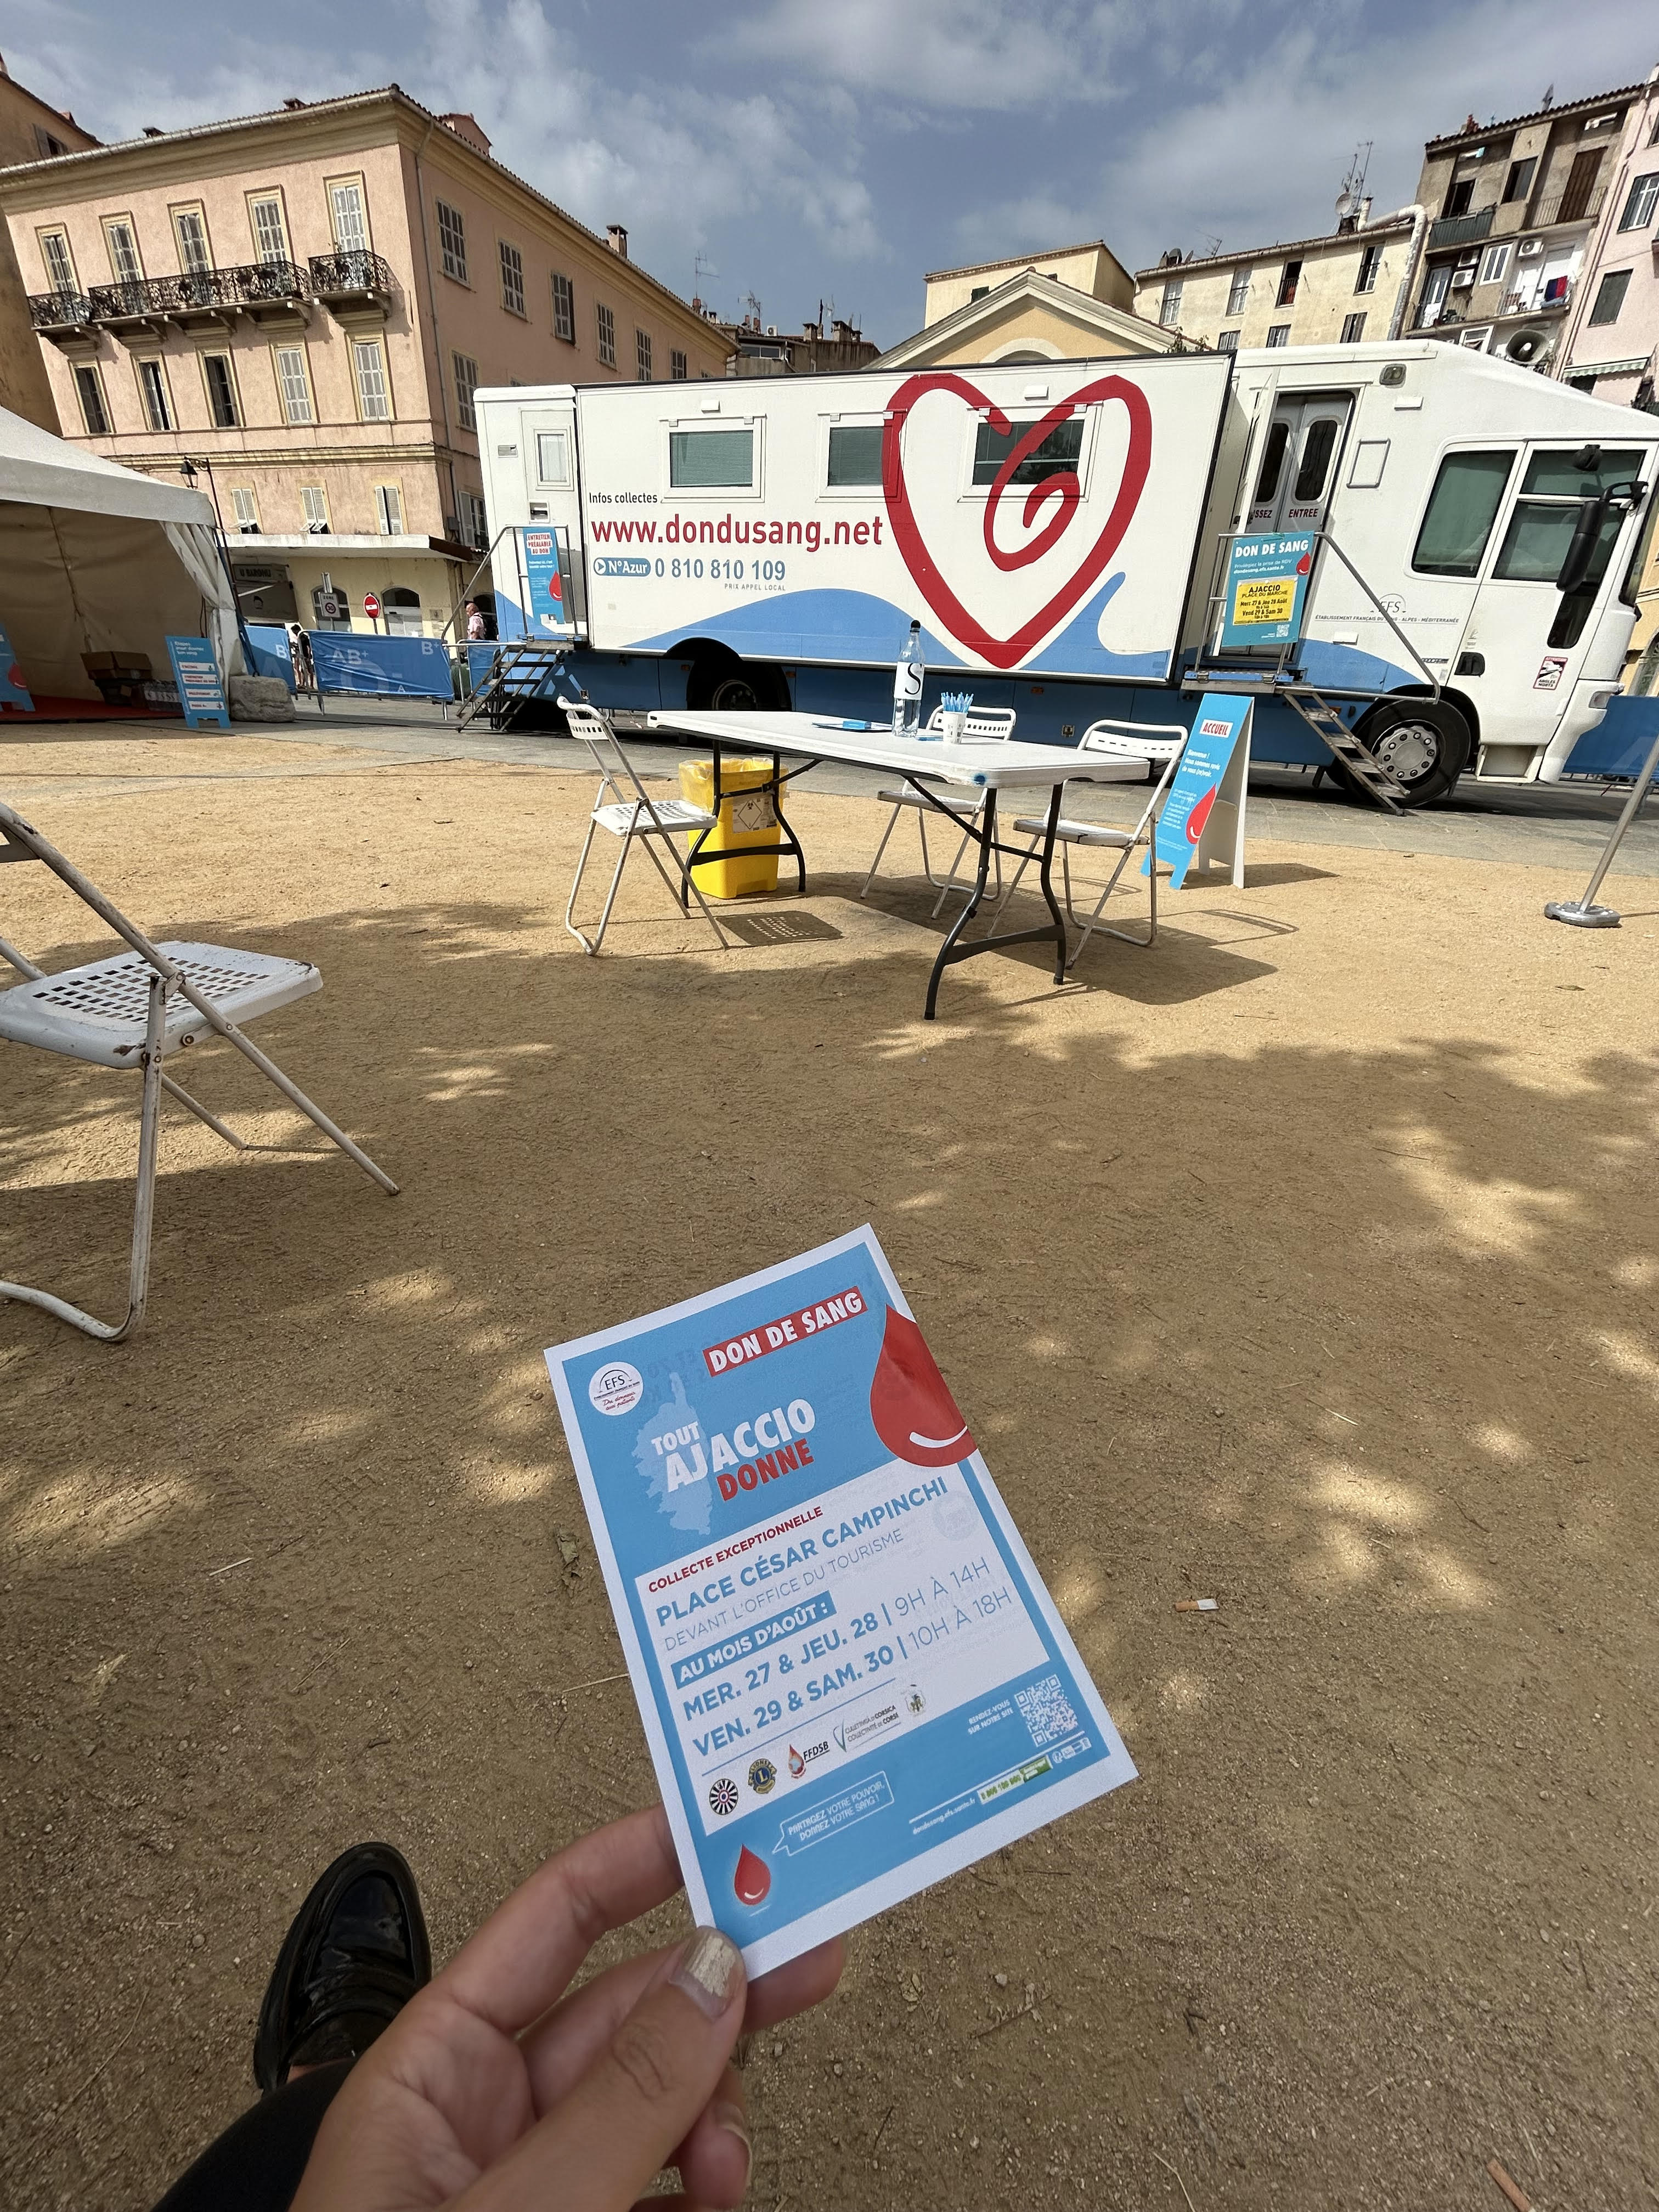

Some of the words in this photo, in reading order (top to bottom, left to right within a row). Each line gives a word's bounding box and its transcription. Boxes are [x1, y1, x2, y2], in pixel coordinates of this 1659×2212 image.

[589, 493, 612, 503] Infos
[615, 493, 658, 503] collectes
[1288, 509, 1318, 517] ENTREE
[591, 514, 883, 552] www.dondusang.net
[1235, 545, 1259, 557] DON
[1262, 543, 1276, 555] DE
[1278, 540, 1308, 554] SANG
[655, 558, 664, 577] 0
[672, 558, 703, 578] 810
[710, 559, 743, 579] 810
[752, 560, 786, 580] 109
[1249, 585, 1280, 593] AJACCIO
[1203, 723, 1229, 735] ACCUEIL
[709, 1333, 762, 1372] DON
[765, 1319, 798, 1348] DE
[802, 1293, 862, 1333] SANG
[605, 1375, 625, 1390] EFS
[651, 1421, 700, 1455] TOUT
[666, 1399, 815, 1492] AJACCIO
[716, 1438, 814, 1501] DONNE
[648, 1556, 714, 1593] COLLECTE
[716, 1506, 823, 1562] EXCEPTIONNELLE
[656, 1576, 736, 1627] PLACE
[741, 1539, 819, 1586] CÉSAR
[822, 1476, 948, 1548] CAMPINCHI
[664, 1611, 728, 1651] DEVANT
[732, 1578, 800, 1619] L'OFFICE
[803, 1566, 825, 1585] DU
[828, 1528, 904, 1572] TOURISME
[680, 1658, 704, 1682] AU
[707, 1636, 752, 1667] MOIS
[754, 1604, 816, 1645] D'AOÛT
[683, 1682, 742, 1721] MER.
[746, 1662, 770, 1691] 27
[779, 1654, 794, 1674] &
[801, 1629, 847, 1664] JEU.
[850, 1612, 878, 1639] 28
[895, 1589, 926, 1616] 9H
[930, 1577, 948, 1600] À
[950, 1557, 990, 1588] 14H
[693, 1718, 751, 1756] VEN.
[754, 1700, 782, 1729] 29
[788, 1691, 803, 1711] &
[806, 1663, 862, 1701] SAM.
[864, 1646, 893, 1672] 30
[909, 1617, 949, 1650] 10H
[953, 1605, 972, 1630] À
[973, 1587, 1012, 1617] 18H
[874, 1705, 896, 1719] CORSICA
[968, 1724, 981, 1735] SUR
[981, 1713, 1001, 1728] NOTRE
[1001, 1707, 1014, 1718] SITE
[969, 1699, 1010, 1724] RENDEZ-VOUS
[803, 1741, 829, 1760] FFDSB
[758, 1769, 768, 1782] L
[788, 1810, 827, 1835] PARTAGEZ
[827, 1797, 851, 1814] VOTRE
[799, 1820, 830, 1841] DONNEZ
[830, 1808, 855, 1824] VOTRE
[855, 1796, 875, 1812] SANG
